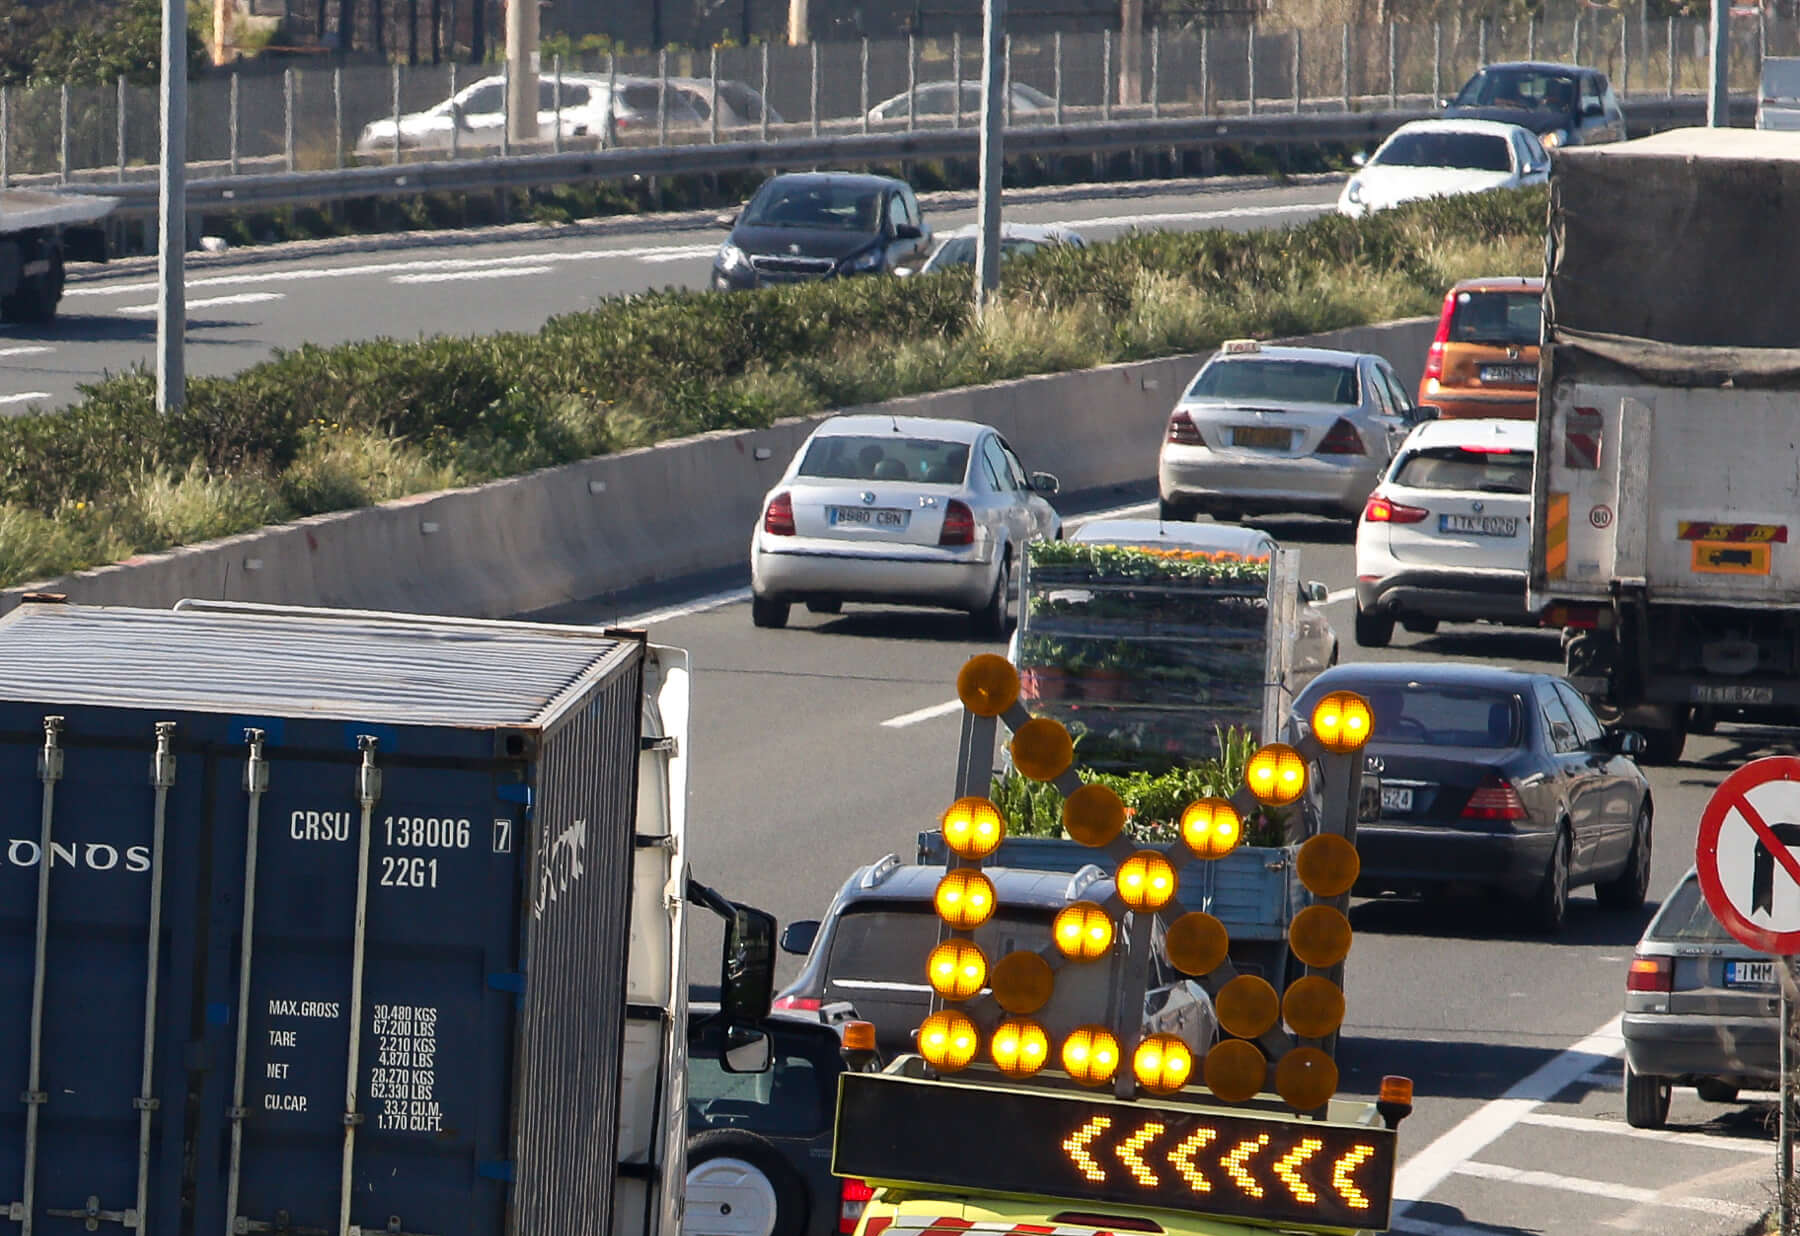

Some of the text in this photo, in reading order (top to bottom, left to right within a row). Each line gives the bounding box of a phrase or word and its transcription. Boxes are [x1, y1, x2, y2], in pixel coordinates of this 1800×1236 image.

[290, 811, 350, 841] CRSU
[384, 816, 471, 849] 138006
[380, 857, 438, 888] 22G1
[374, 1005, 412, 1021] 30.480
[414, 1007, 437, 1022] KGS
[373, 1020, 435, 1037] 67.200 LBS
[269, 1030, 436, 1053] TARE 2.210 KGS
[378, 1052, 434, 1068] 4.870 LBS
[267, 1063, 435, 1086] NET 28.270 KGS
[371, 1083, 433, 1100] 62.330 LBS
[384, 1100, 408, 1116] 33.2
[378, 1114, 407, 1130] 1.170
